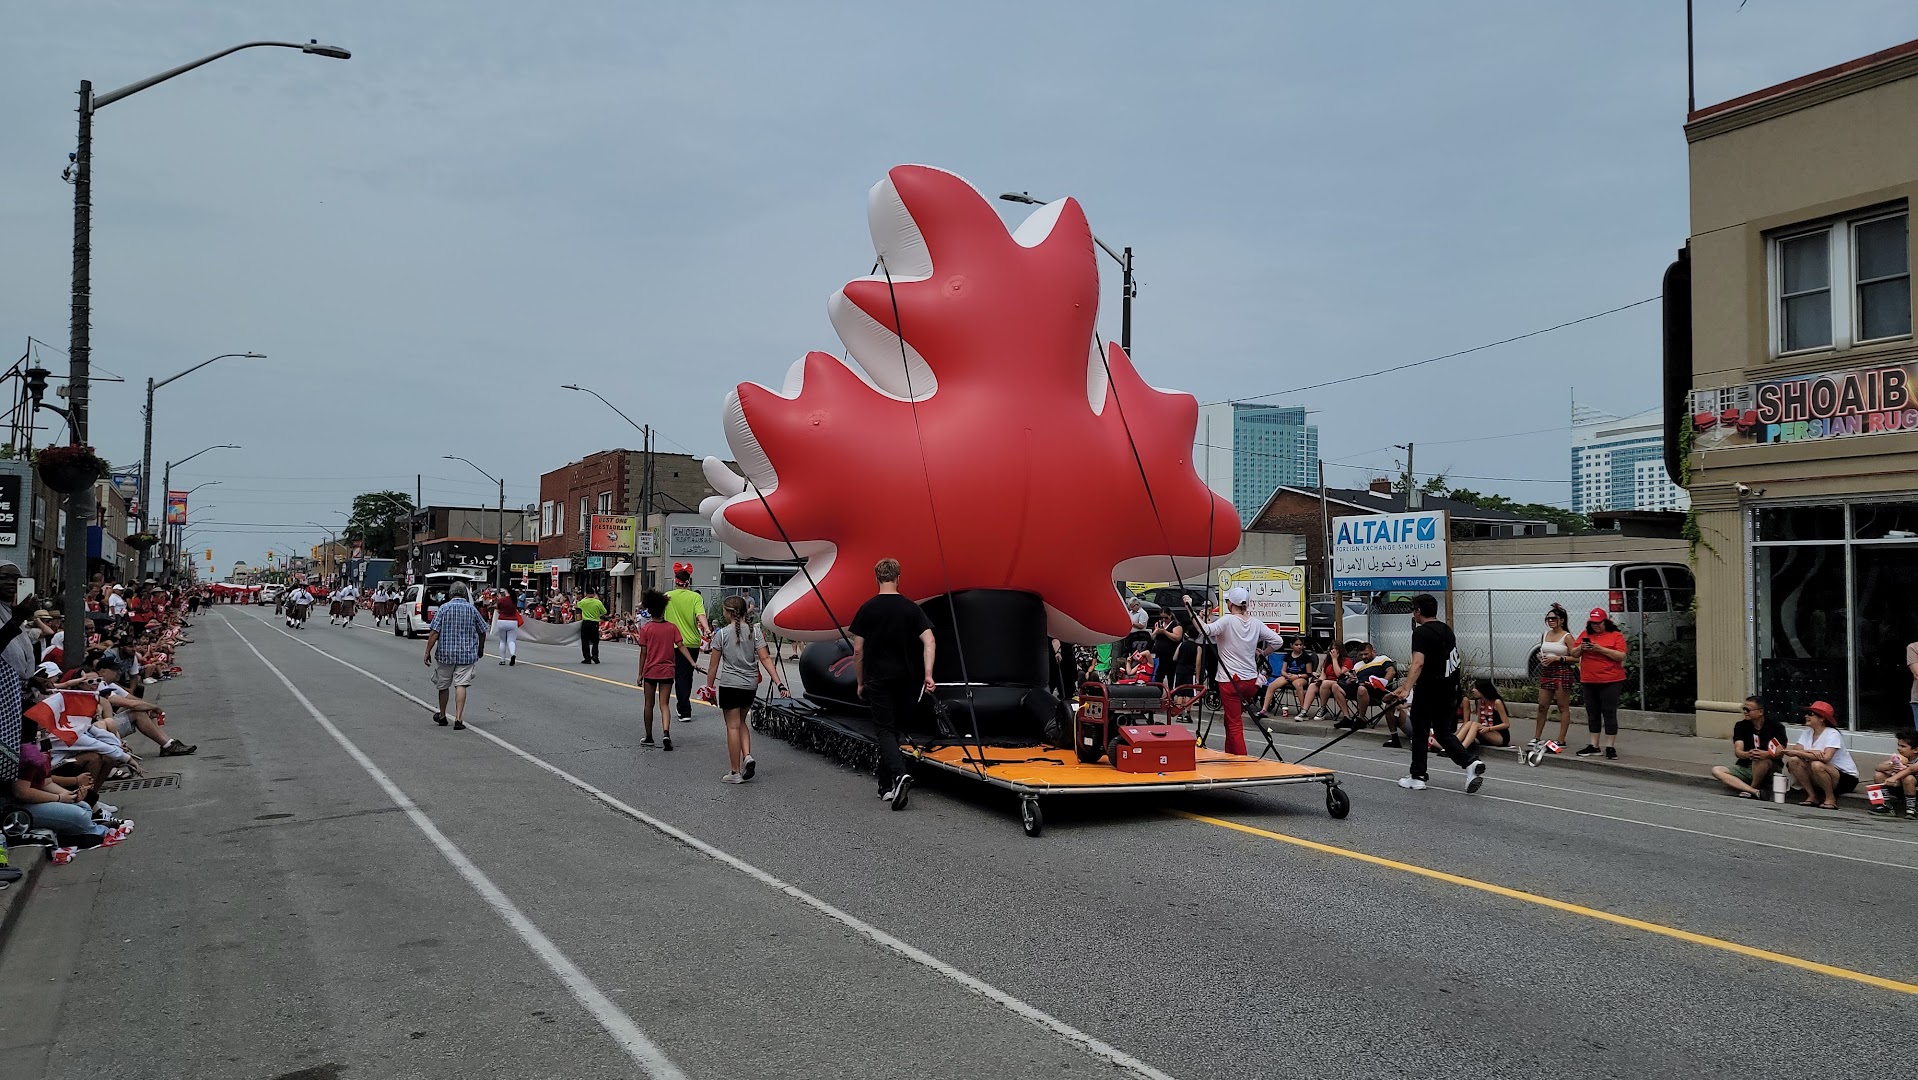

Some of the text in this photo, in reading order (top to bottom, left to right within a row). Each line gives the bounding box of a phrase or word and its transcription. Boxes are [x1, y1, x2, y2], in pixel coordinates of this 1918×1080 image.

[1757, 368, 1909, 424] SHOAIB
[1766, 415, 1863, 444] PERSIAN
[673, 528, 705, 537] CHICKEN
[1337, 518, 1415, 545] ALTAIF
[1362, 544, 1396, 552] EXCHANGE
[1398, 543, 1436, 551] SIMPLIFIED
[1367, 555, 1403, 573] وتحويل
[1405, 554, 1442, 572] صرافة
[1290, 573, 1302, 582] 742
[1338, 579, 1441, 587] 519-962-5899 WWW.TAIFCO.COM
[1257, 600, 1286, 608] Supermarket
